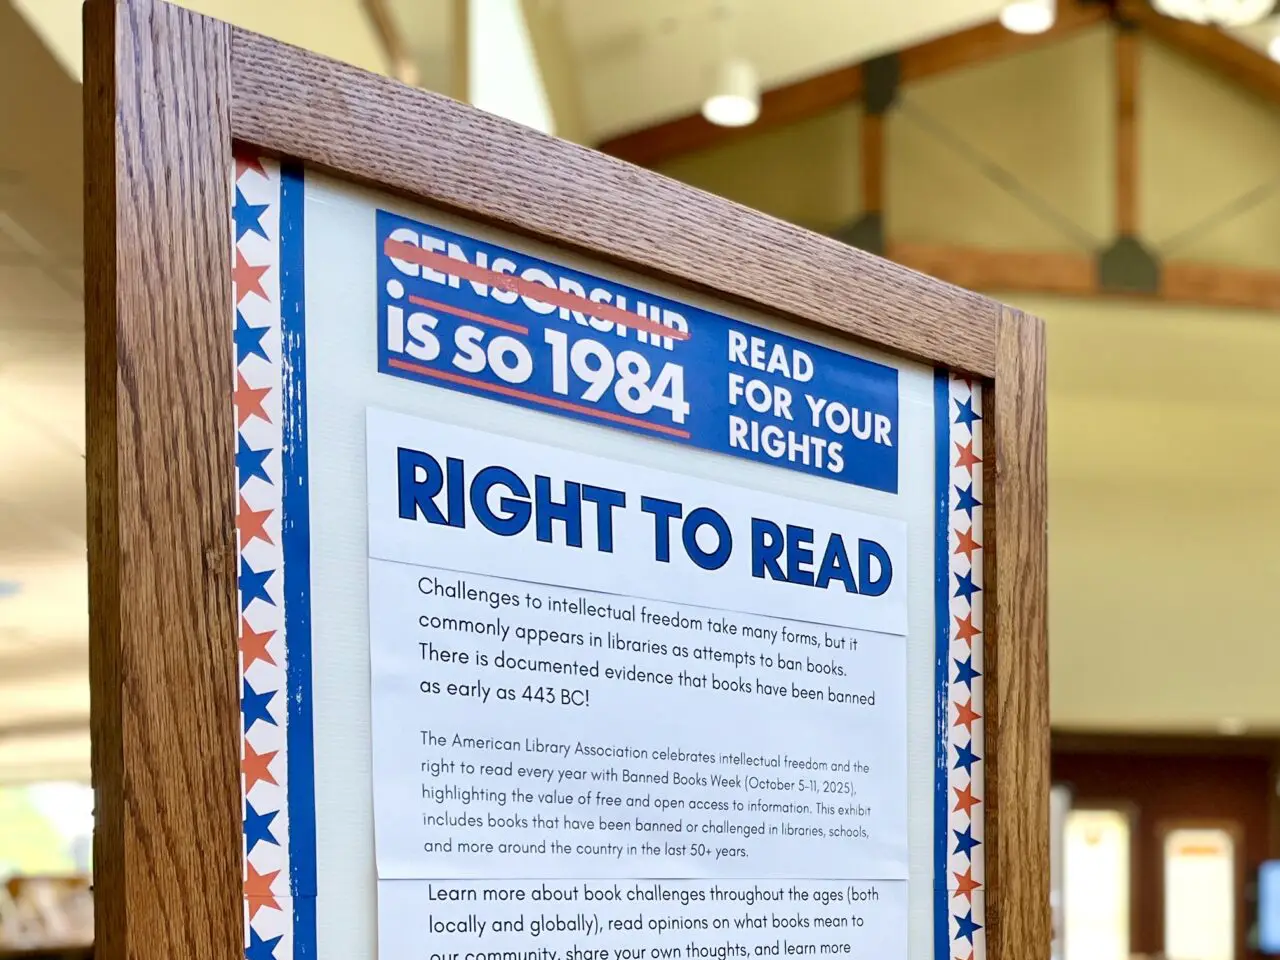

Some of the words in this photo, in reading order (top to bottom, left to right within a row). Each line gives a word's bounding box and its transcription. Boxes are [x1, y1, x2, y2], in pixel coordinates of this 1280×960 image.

[386, 228, 690, 351] CENSORSHIP
[386, 279, 441, 361] is
[452, 328, 533, 384] so
[544, 328, 690, 424] 1984
[728, 329, 814, 382] READ
[728, 373, 792, 420] FOR
[805, 395, 893, 447] YOUR
[728, 415, 845, 473] RIGHTS
[397, 447, 626, 553] RIGHT
[641, 496, 732, 570] TO
[751, 517, 893, 597] READ
[418, 577, 520, 609] Challenges
[524, 593, 542, 609] to
[548, 596, 636, 622] intellectual
[640, 606, 702, 630] freedom
[707, 618, 738, 635] take
[742, 626, 778, 645] many
[781, 626, 821, 648] forms,
[825, 632, 846, 649] but
[850, 638, 858, 650] it
[419, 616, 510, 642] commonly
[515, 627, 584, 646] appears
[590, 632, 602, 647] in
[608, 632, 668, 655] libraries
[672, 646, 688, 658] as
[693, 646, 756, 668] attempts
[759, 653, 774, 668] to
[778, 652, 802, 671] ban
[807, 656, 846, 676] books.
[418, 642, 469, 664] There
[476, 650, 488, 666] is
[494, 650, 599, 678] documented
[604, 664, 674, 684] evidence
[678, 670, 708, 688] that
[712, 673, 752, 693] books
[756, 678, 787, 696] have
[792, 682, 824, 700] been
[828, 686, 875, 706] banned
[420, 681, 440, 694] as
[446, 680, 490, 704] early
[496, 688, 516, 700] as
[521, 685, 556, 704] 443
[561, 688, 589, 707] BC!
[420, 730, 447, 746] The
[452, 733, 520, 751] American
[526, 738, 570, 758] Library
[574, 742, 648, 759] Association
[652, 747, 716, 764] celebrates
[719, 752, 780, 768] intellectual
[784, 755, 828, 770] freedom
[831, 760, 850, 772] and
[853, 761, 869, 773] the
[423, 810, 483, 828] includes
[488, 812, 528, 828] books
[532, 814, 560, 829] that
[564, 814, 594, 830] have
[599, 816, 631, 831] been
[636, 817, 682, 832] banned
[686, 824, 698, 832] or
[702, 820, 765, 838] challenged
[769, 824, 778, 834] in
[782, 822, 826, 838] libraries,
[829, 824, 869, 838] schools,
[424, 837, 452, 852] and
[458, 843, 494, 853] more
[498, 840, 546, 854] around
[550, 840, 572, 854] the
[576, 843, 623, 859] country
[627, 846, 637, 855] in
[641, 842, 661, 856] the
[665, 842, 687, 856] last
[689, 844, 712, 856] 50+
[716, 848, 748, 860] years.
[428, 884, 476, 901] Learn
[483, 890, 526, 901] more
[531, 883, 579, 901] about
[584, 884, 622, 901] book
[626, 884, 706, 906] challenges
[709, 885, 784, 906] throughout
[788, 885, 809, 901] the
[813, 891, 844, 906] ages
[847, 886, 878, 904] (both
[430, 914, 486, 938] locally
[492, 914, 524, 932] and
[530, 913, 603, 937] globally),
[608, 913, 643, 930] read
[648, 916, 708, 935] opinions
[712, 918, 730, 929] on
[734, 912, 768, 929] what
[772, 912, 810, 928] books
[814, 918, 848, 928] mean
[851, 914, 864, 927] to
[650, 948, 681, 959] own
[754, 940, 780, 956] and
[784, 940, 816, 955] learn
[820, 944, 851, 954] more
